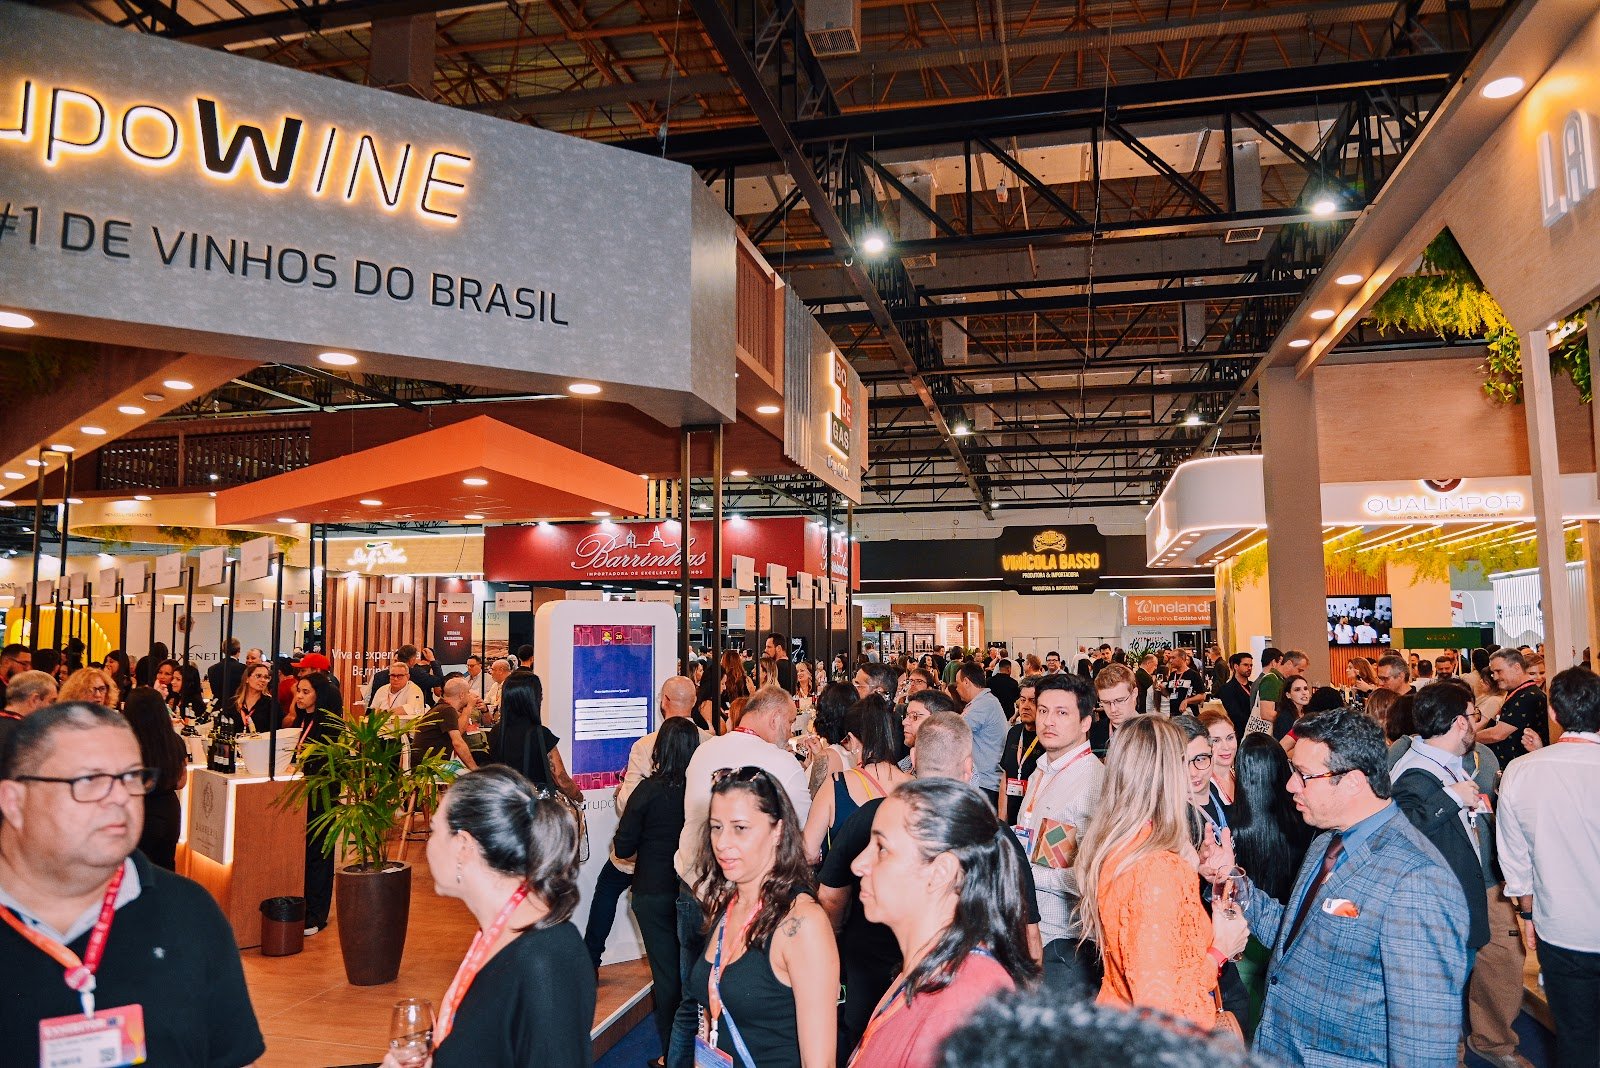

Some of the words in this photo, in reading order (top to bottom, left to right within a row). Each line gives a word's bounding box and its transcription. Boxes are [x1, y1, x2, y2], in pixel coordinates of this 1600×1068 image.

[61, 212, 131, 259] DE
[151, 225, 338, 290] VINHOS
[354, 259, 415, 301] DO
[430, 272, 570, 327] BRASIL
[832, 420, 849, 450] GAS
[1367, 495, 1521, 513] QUALIMPOR
[571, 532, 707, 570] Barrinhas
[1002, 552, 1057, 571] VINÍCOLA
[1059, 552, 1100, 570] BASSO
[1135, 600, 1210, 614] Winelands
[332, 649, 352, 660] Viva
[354, 651, 361, 660] a
[584, 799, 616, 811] rupo
